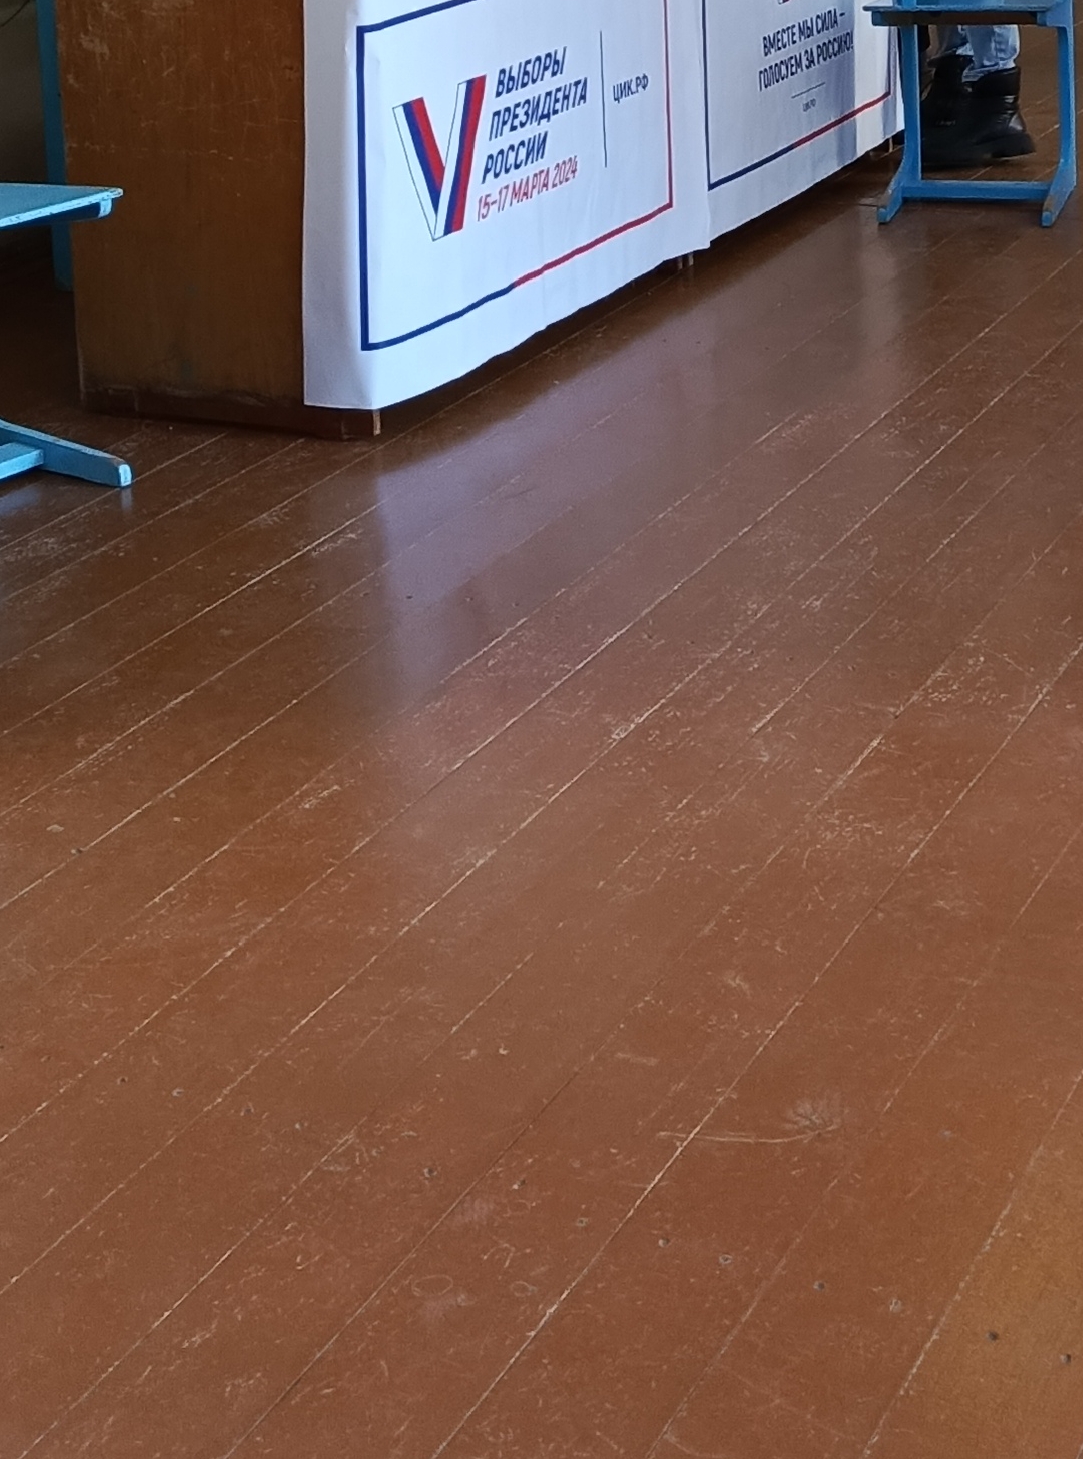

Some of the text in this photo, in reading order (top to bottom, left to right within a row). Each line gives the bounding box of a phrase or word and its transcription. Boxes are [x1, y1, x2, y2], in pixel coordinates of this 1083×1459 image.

[762, 24, 797, 57] ВМЕСТЕ
[798, 16, 814, 42] МЫ
[815, 8, 839, 35] СИЛА
[495, 46, 568, 98] ВЫБОРЫ
[758, 30, 854, 92] ГОЛОСУЕМ ЗА РОССИЮ!
[489, 77, 589, 141] ПРЕЗИДЕНТА
[612, 73, 650, 104] ЦИК.РФ
[481, 130, 549, 185] РОССИИ
[509, 165, 551, 207] МАРТА
[551, 154, 579, 190] 2024
